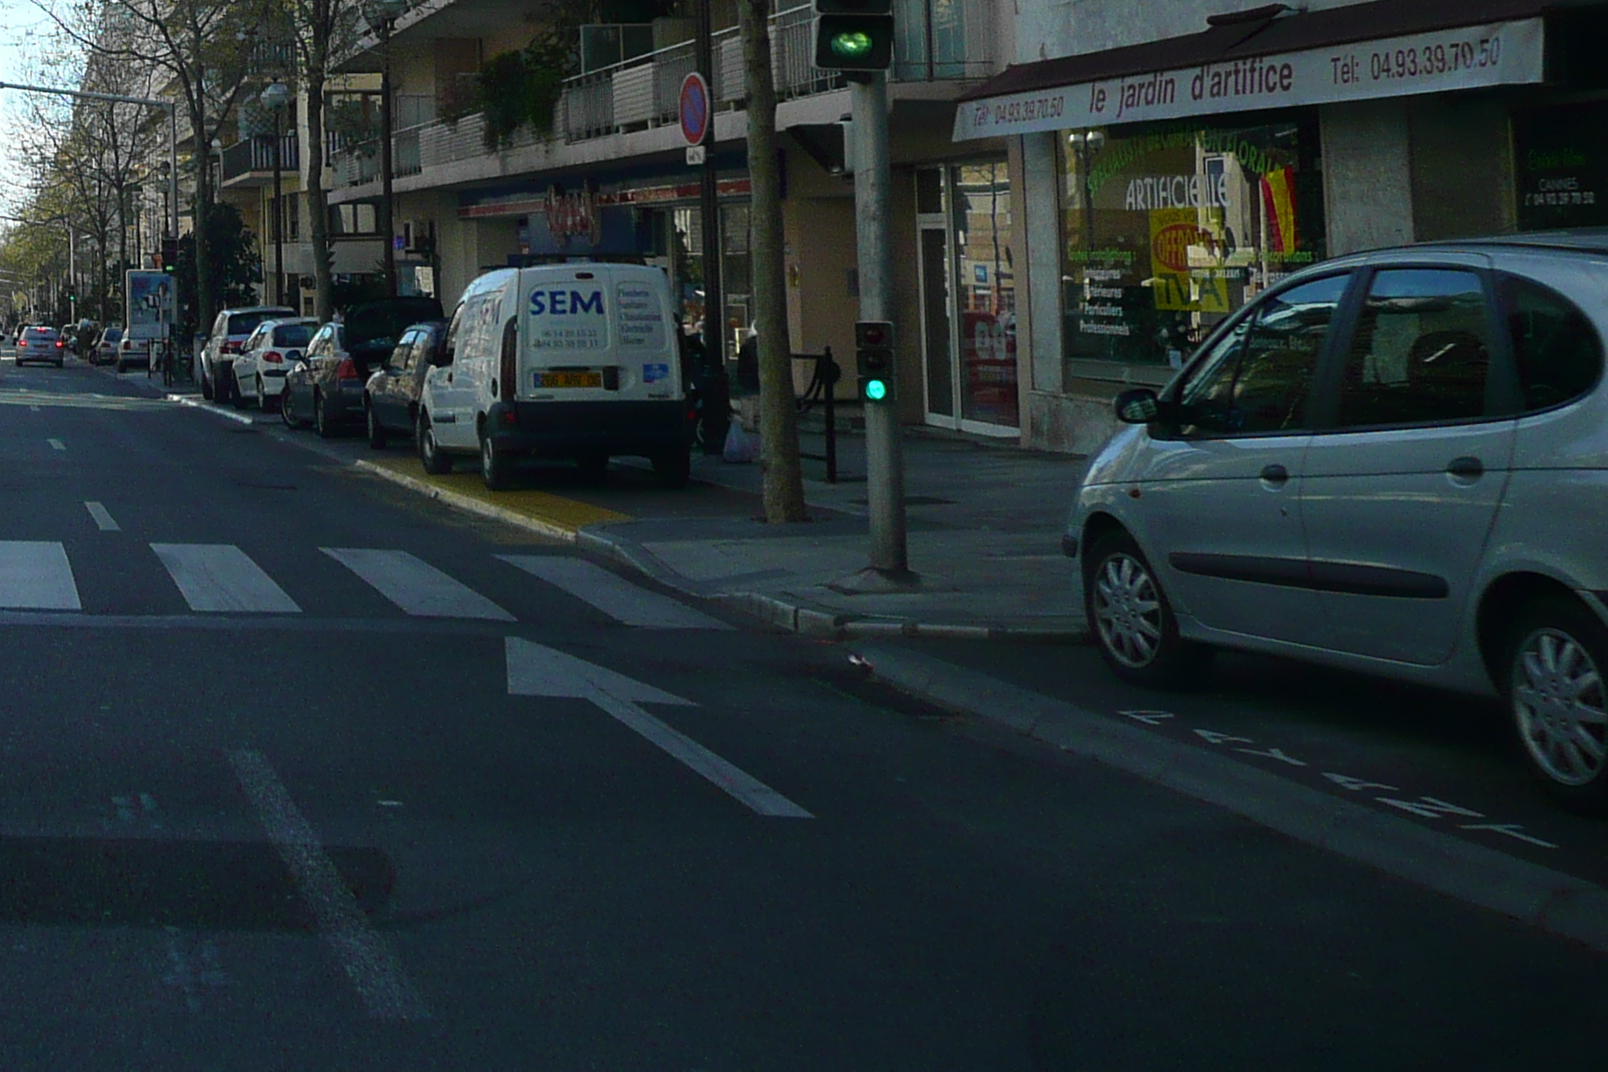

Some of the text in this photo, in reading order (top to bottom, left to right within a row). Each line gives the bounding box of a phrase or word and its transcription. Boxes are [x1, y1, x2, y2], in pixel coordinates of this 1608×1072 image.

[1370, 35, 1501, 80] 04.93.39.70.50
[1089, 58, 1293, 119] le jardin d'artifice
[995, 95, 1064, 125] 04.93.39.70.50
[1125, 174, 1231, 211] ARTIFICIELLE
[530, 291, 604, 315] SEM
